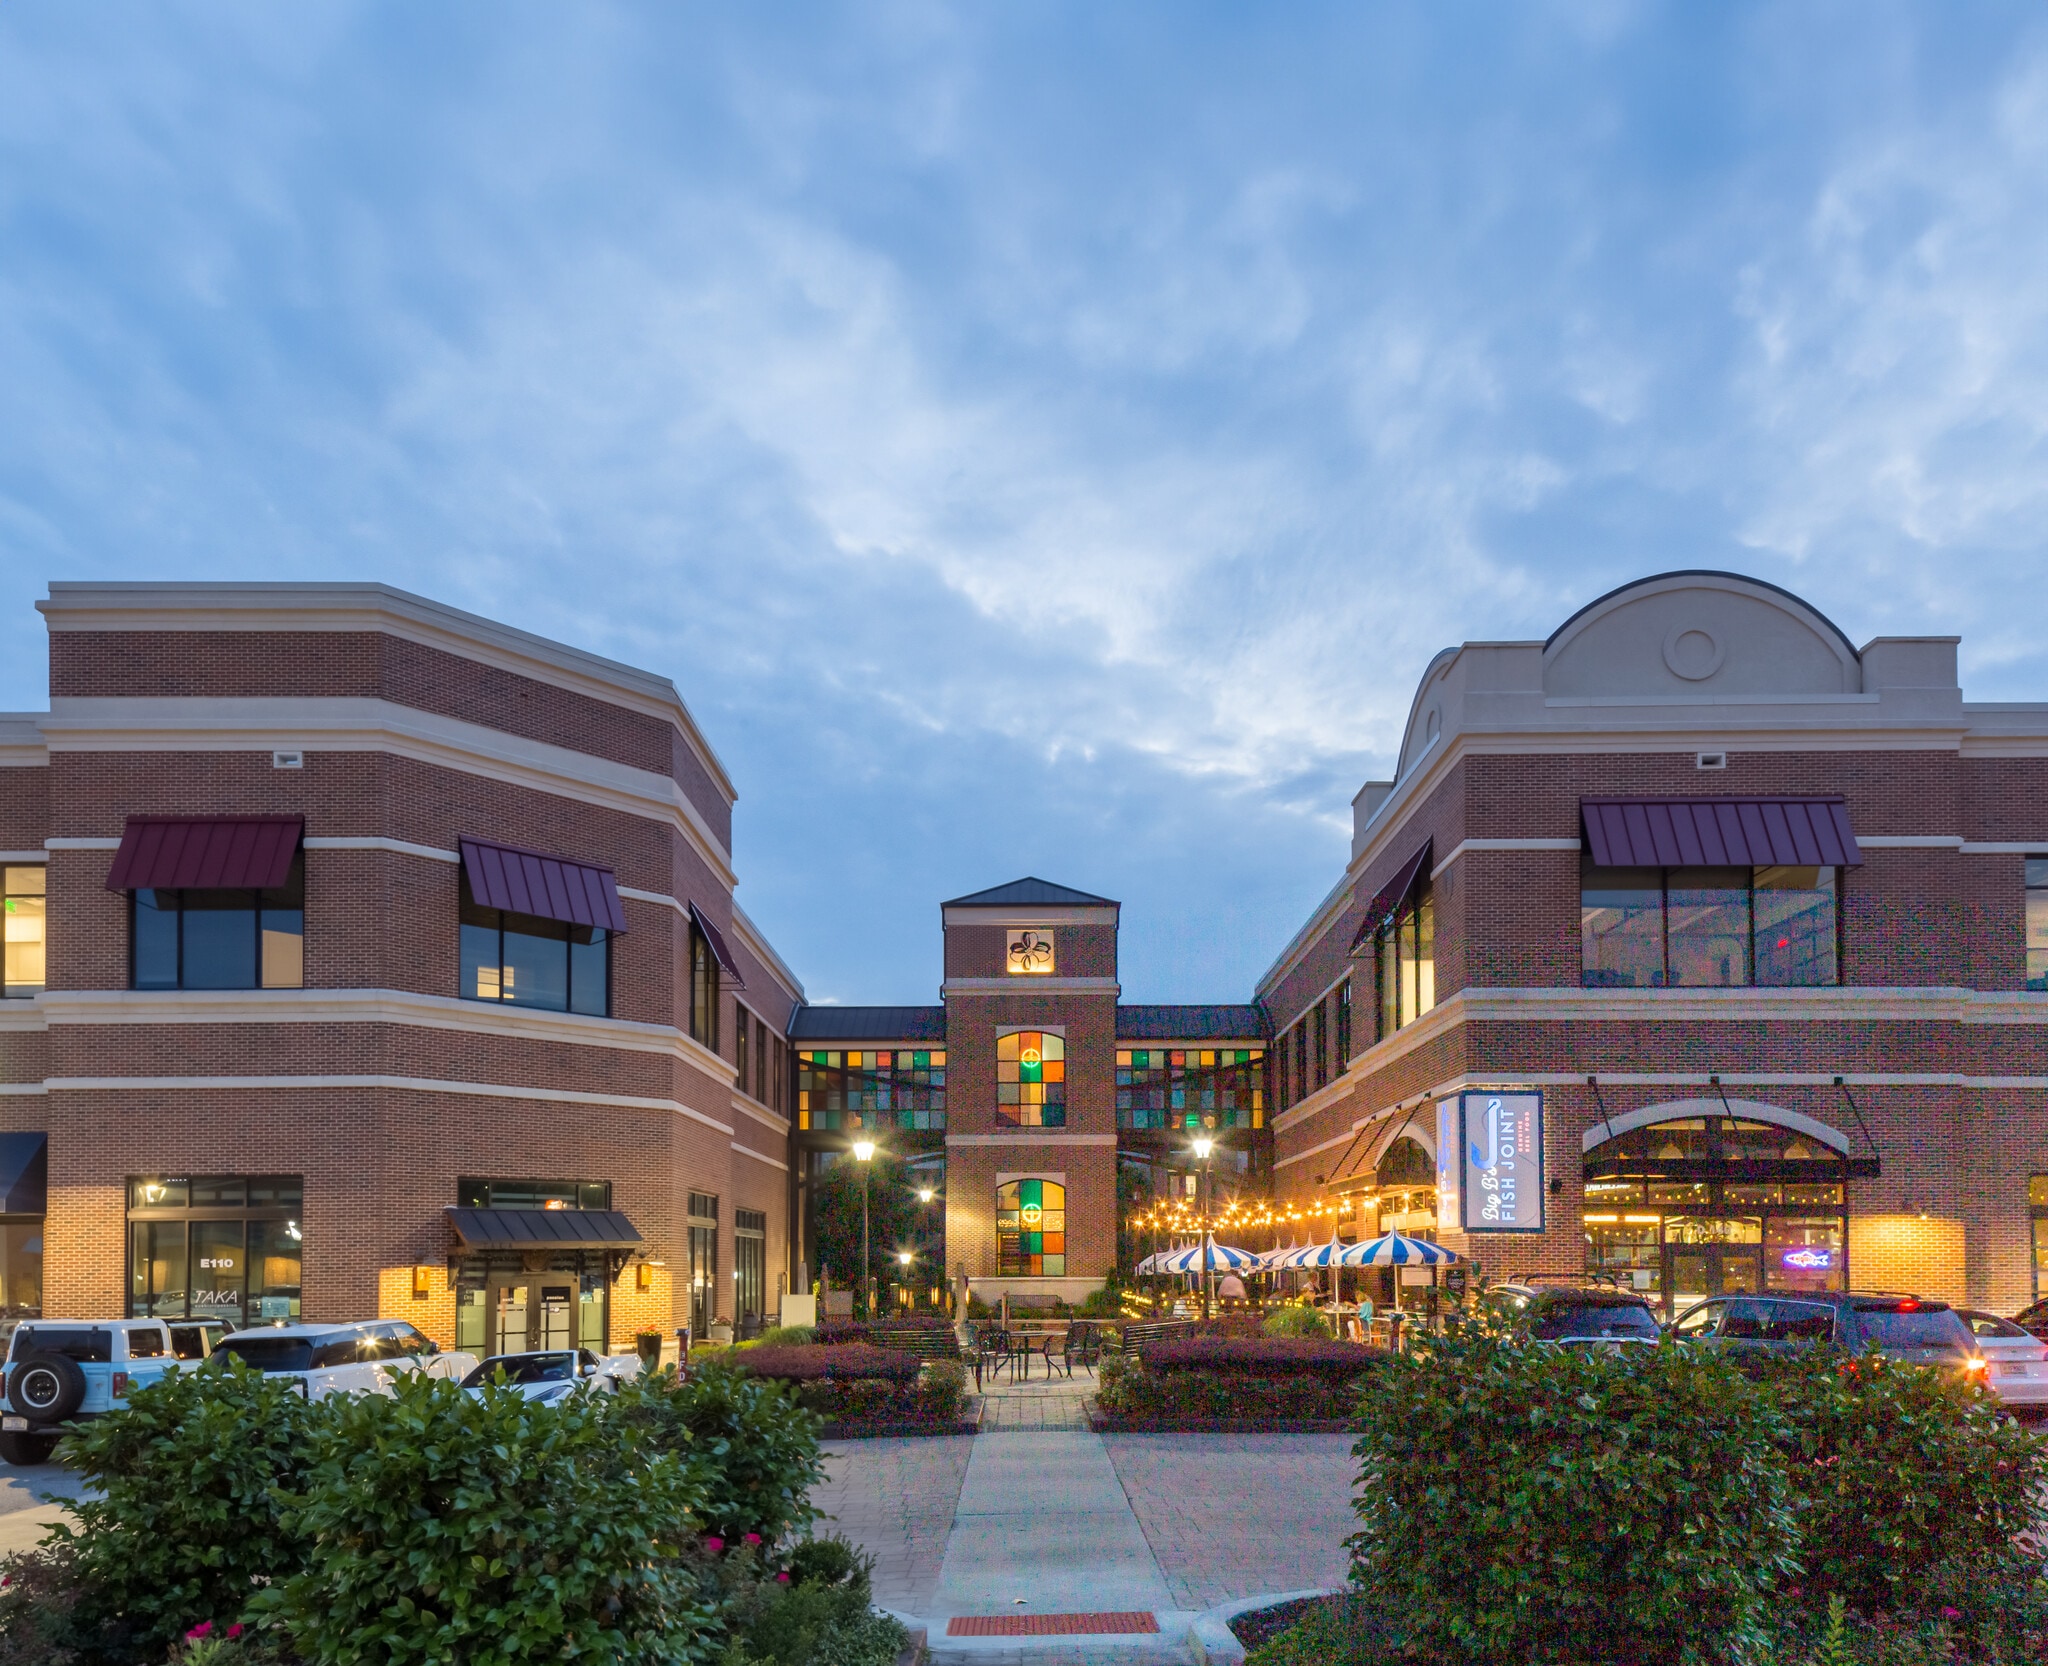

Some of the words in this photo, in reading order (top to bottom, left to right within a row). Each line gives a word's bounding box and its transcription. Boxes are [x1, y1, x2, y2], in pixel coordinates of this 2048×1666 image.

[1500, 1109, 1516, 1170] JOINT
[1481, 1166, 1498, 1191] B's
[1481, 1194, 1501, 1221] Big
[1501, 1178, 1516, 1221] FISH
[200, 1258, 234, 1269] E110
[194, 1290, 238, 1304] TAKA
